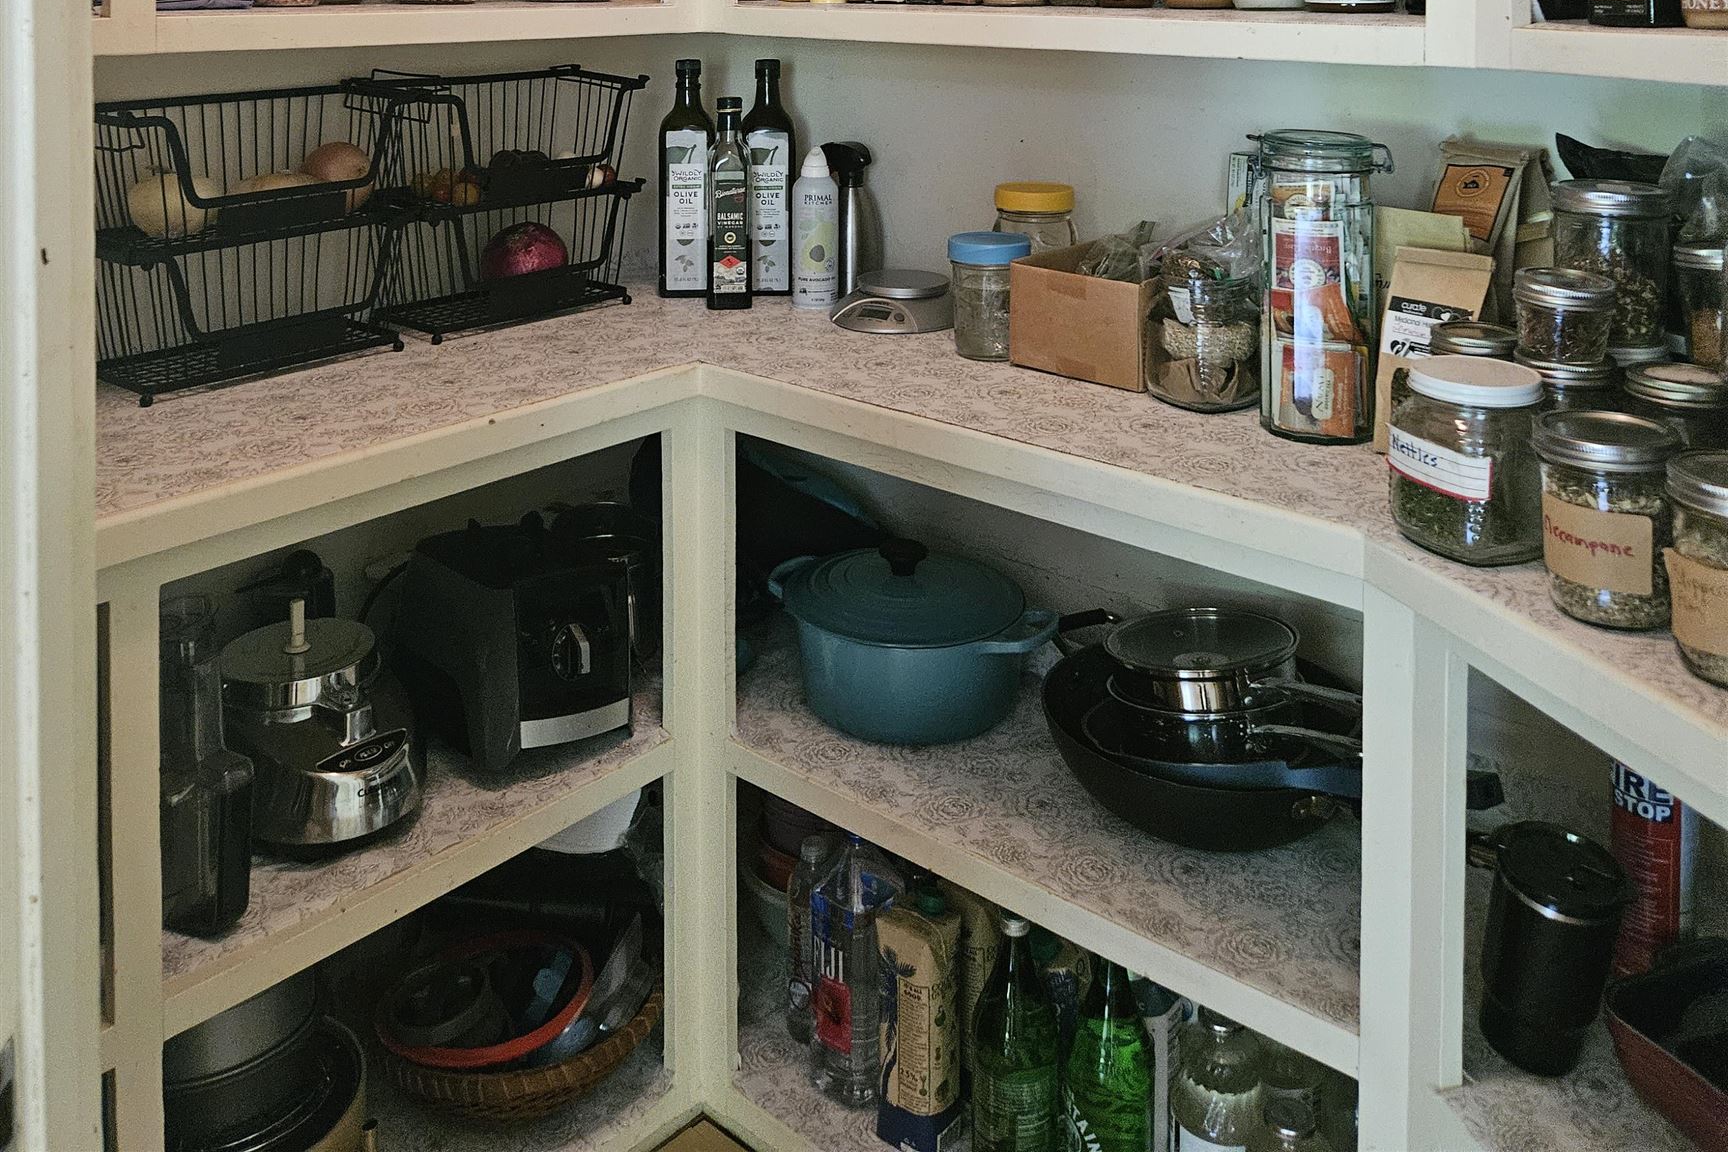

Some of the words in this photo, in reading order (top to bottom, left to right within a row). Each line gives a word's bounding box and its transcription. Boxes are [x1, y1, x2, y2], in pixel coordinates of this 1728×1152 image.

[717, 212, 744, 221] BALSAMIC
[1401, 301, 1427, 313] curate
[1392, 433, 1438, 467] Nettles
[1615, 789, 1671, 822] STOP
